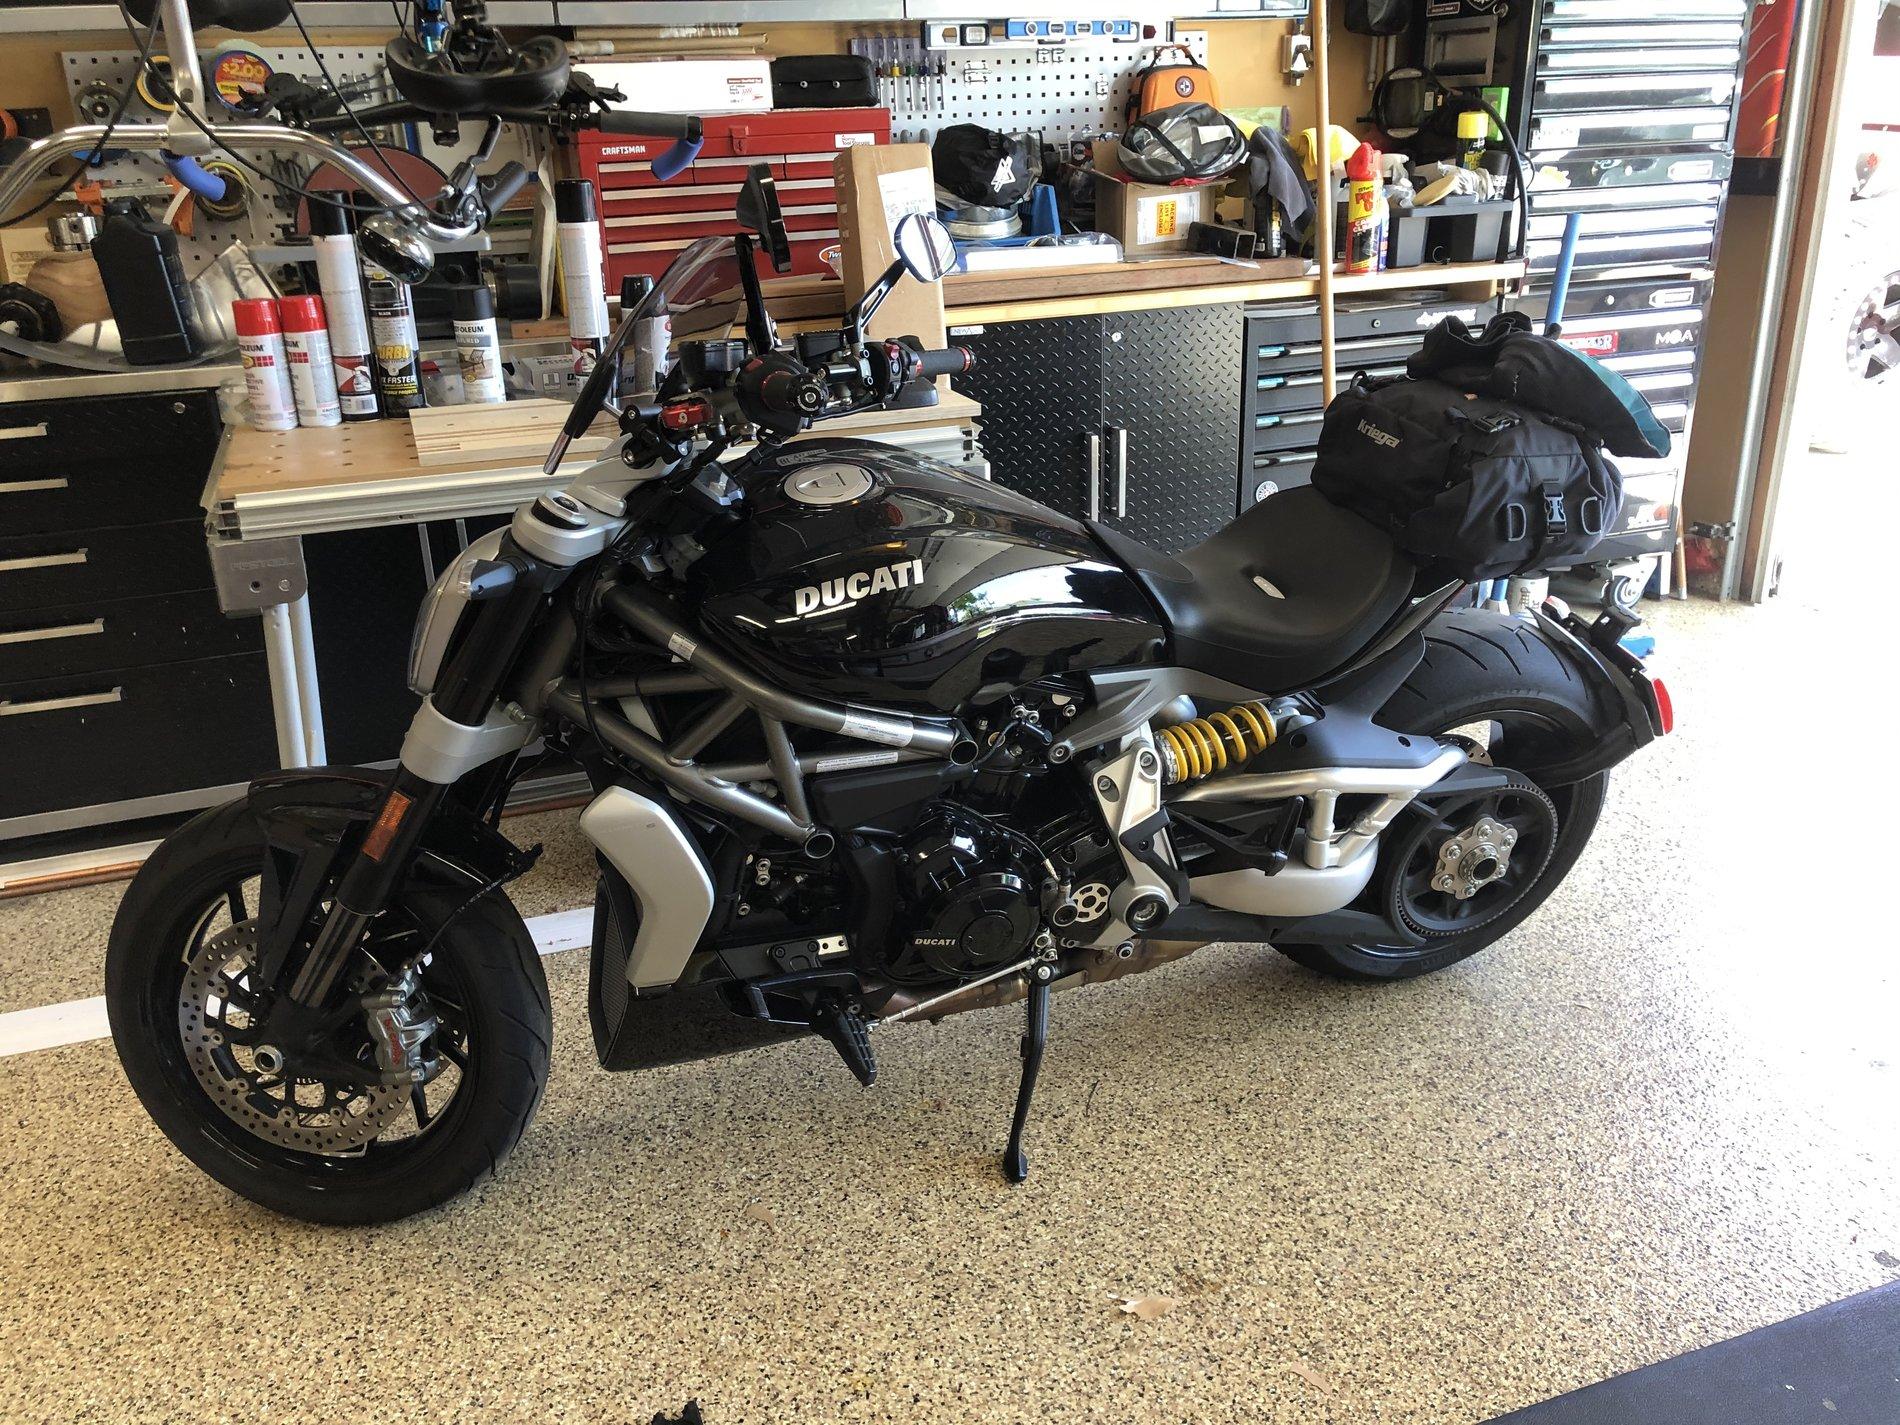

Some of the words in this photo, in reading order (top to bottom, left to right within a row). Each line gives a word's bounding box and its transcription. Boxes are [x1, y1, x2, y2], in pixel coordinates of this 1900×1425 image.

[601, 145, 646, 156] CRAFTSMAN
[387, 375, 416, 384] FASTER
[794, 559, 925, 616] DUCATI
[914, 938, 957, 946] DUCATI
